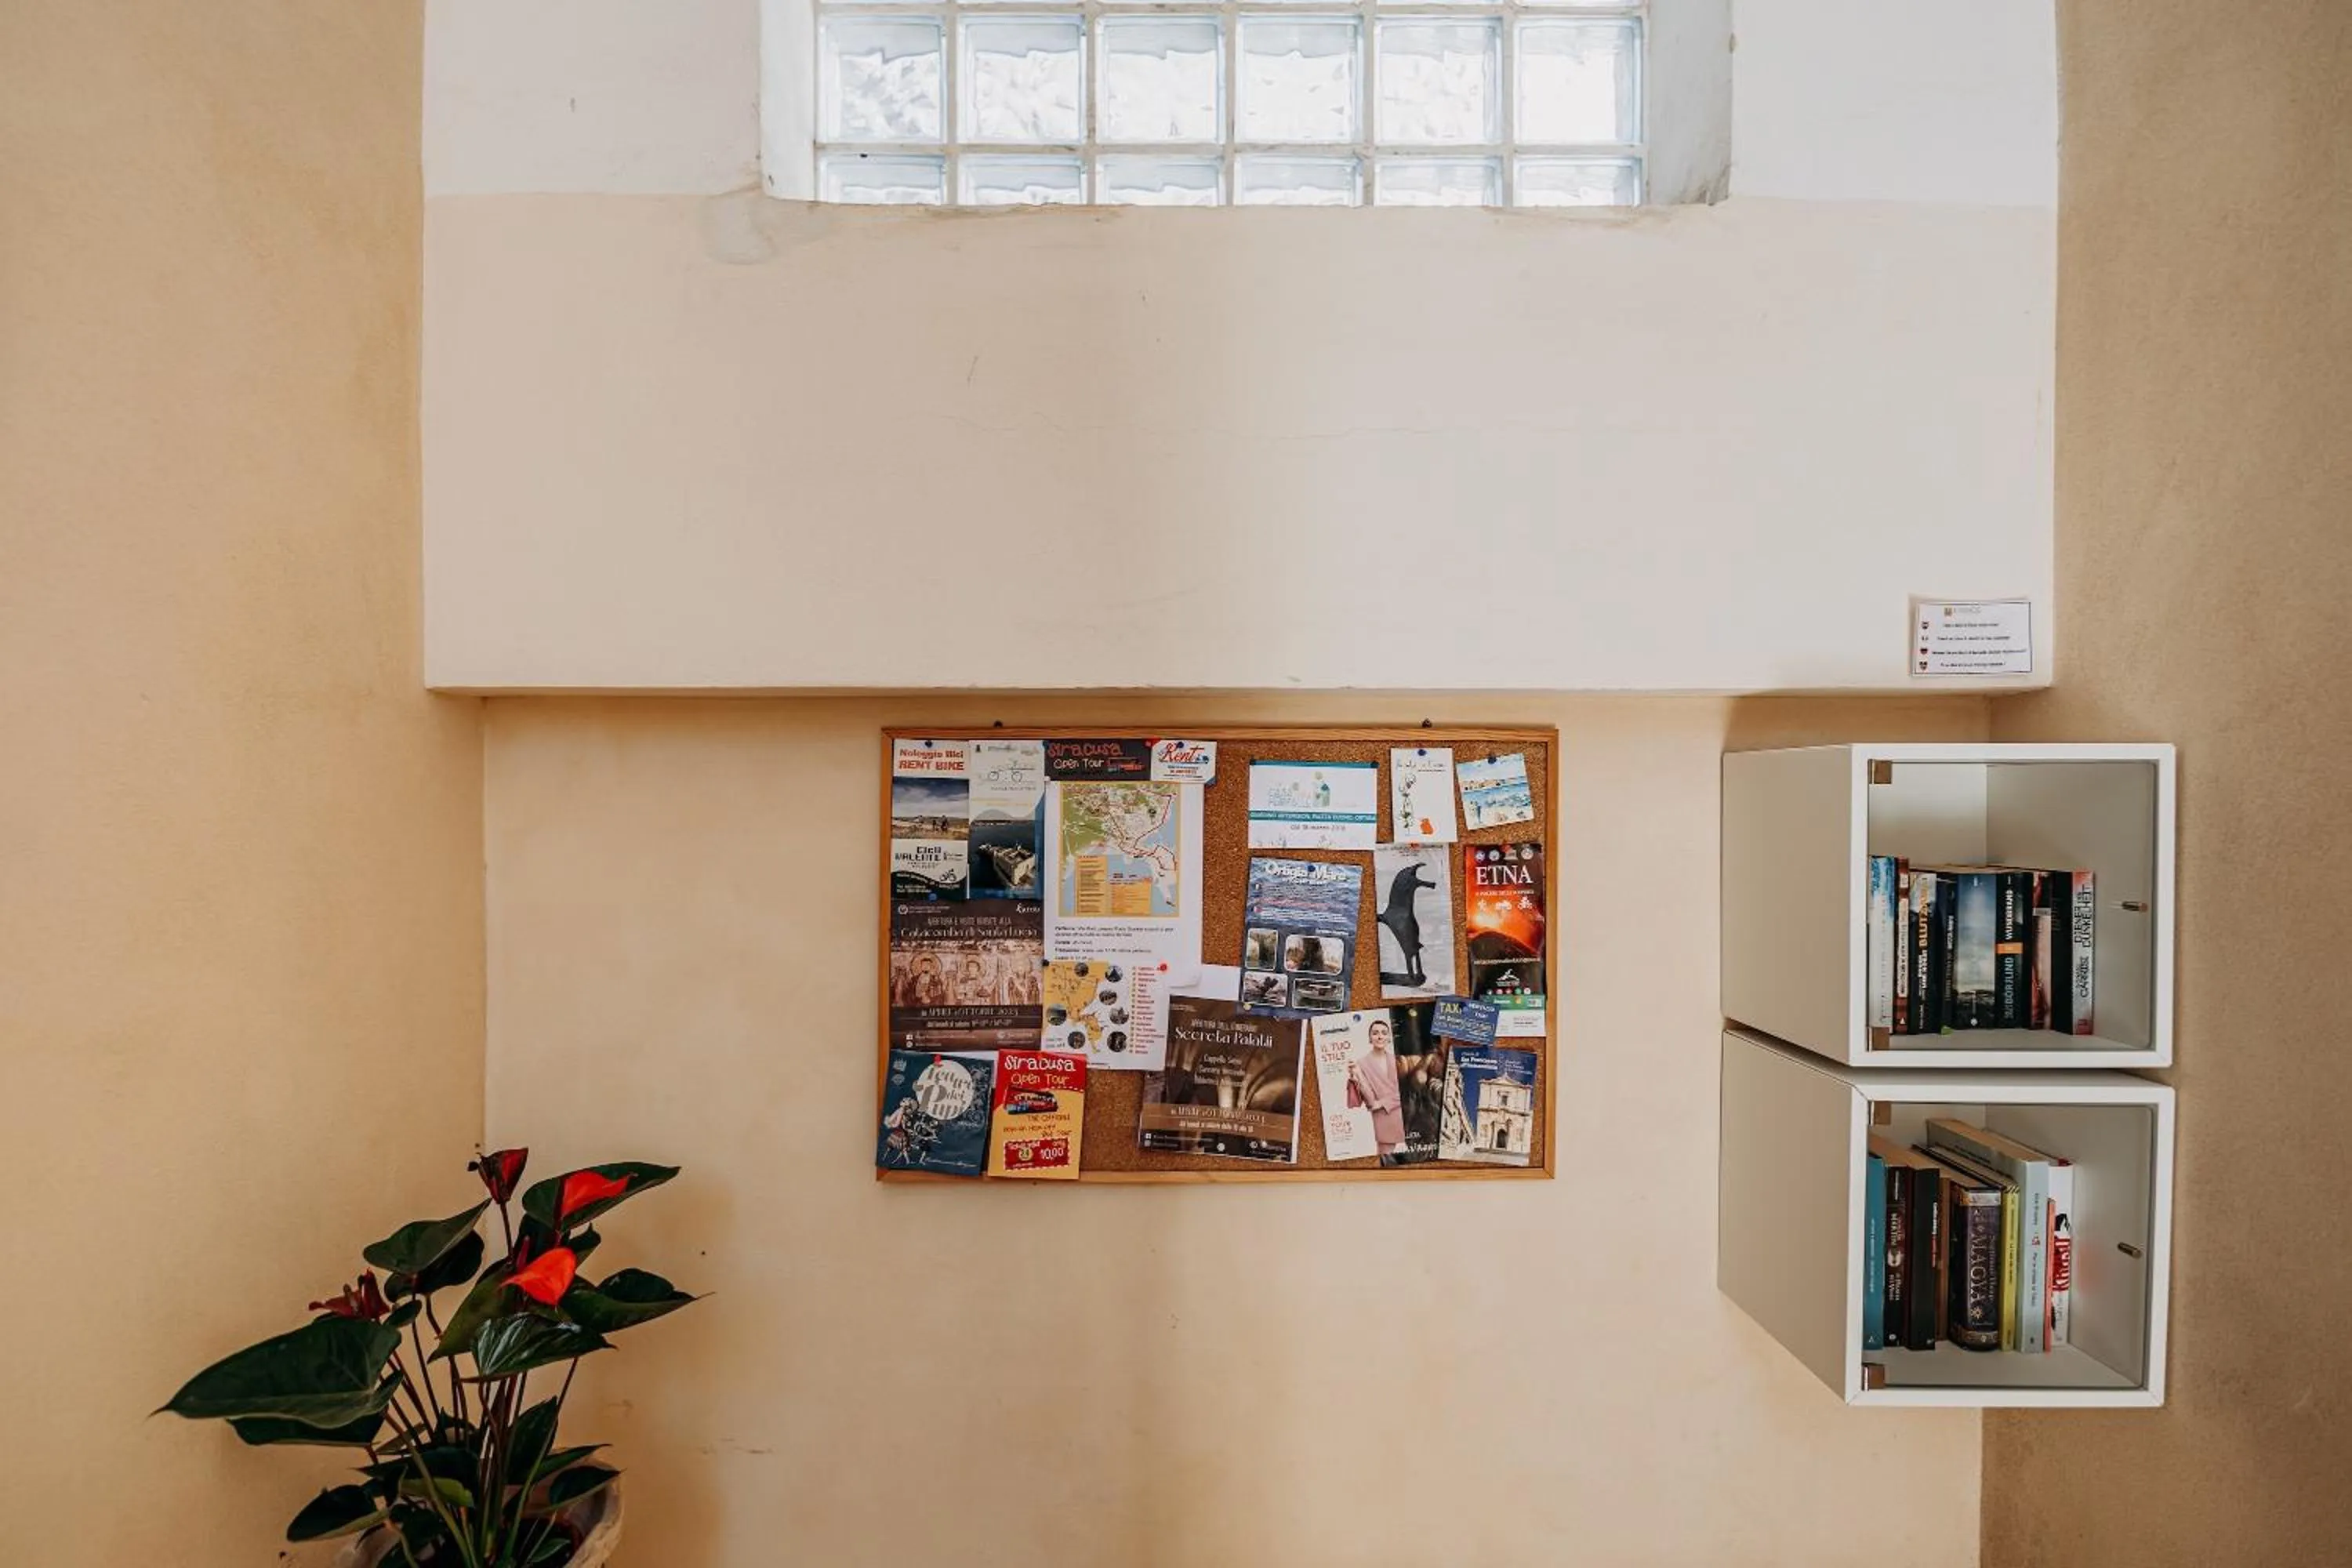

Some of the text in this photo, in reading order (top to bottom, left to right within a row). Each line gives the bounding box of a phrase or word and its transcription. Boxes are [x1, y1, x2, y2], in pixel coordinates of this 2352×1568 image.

[899, 749, 942, 759] Noleggio
[898, 760, 965, 771] RENT BIKE
[1053, 757, 1105, 770] Open Tour
[1475, 865, 1534, 885] ETNA
[1004, 1054, 1076, 1072] Siracusa
[1011, 1072, 1069, 1085] Open Tour
